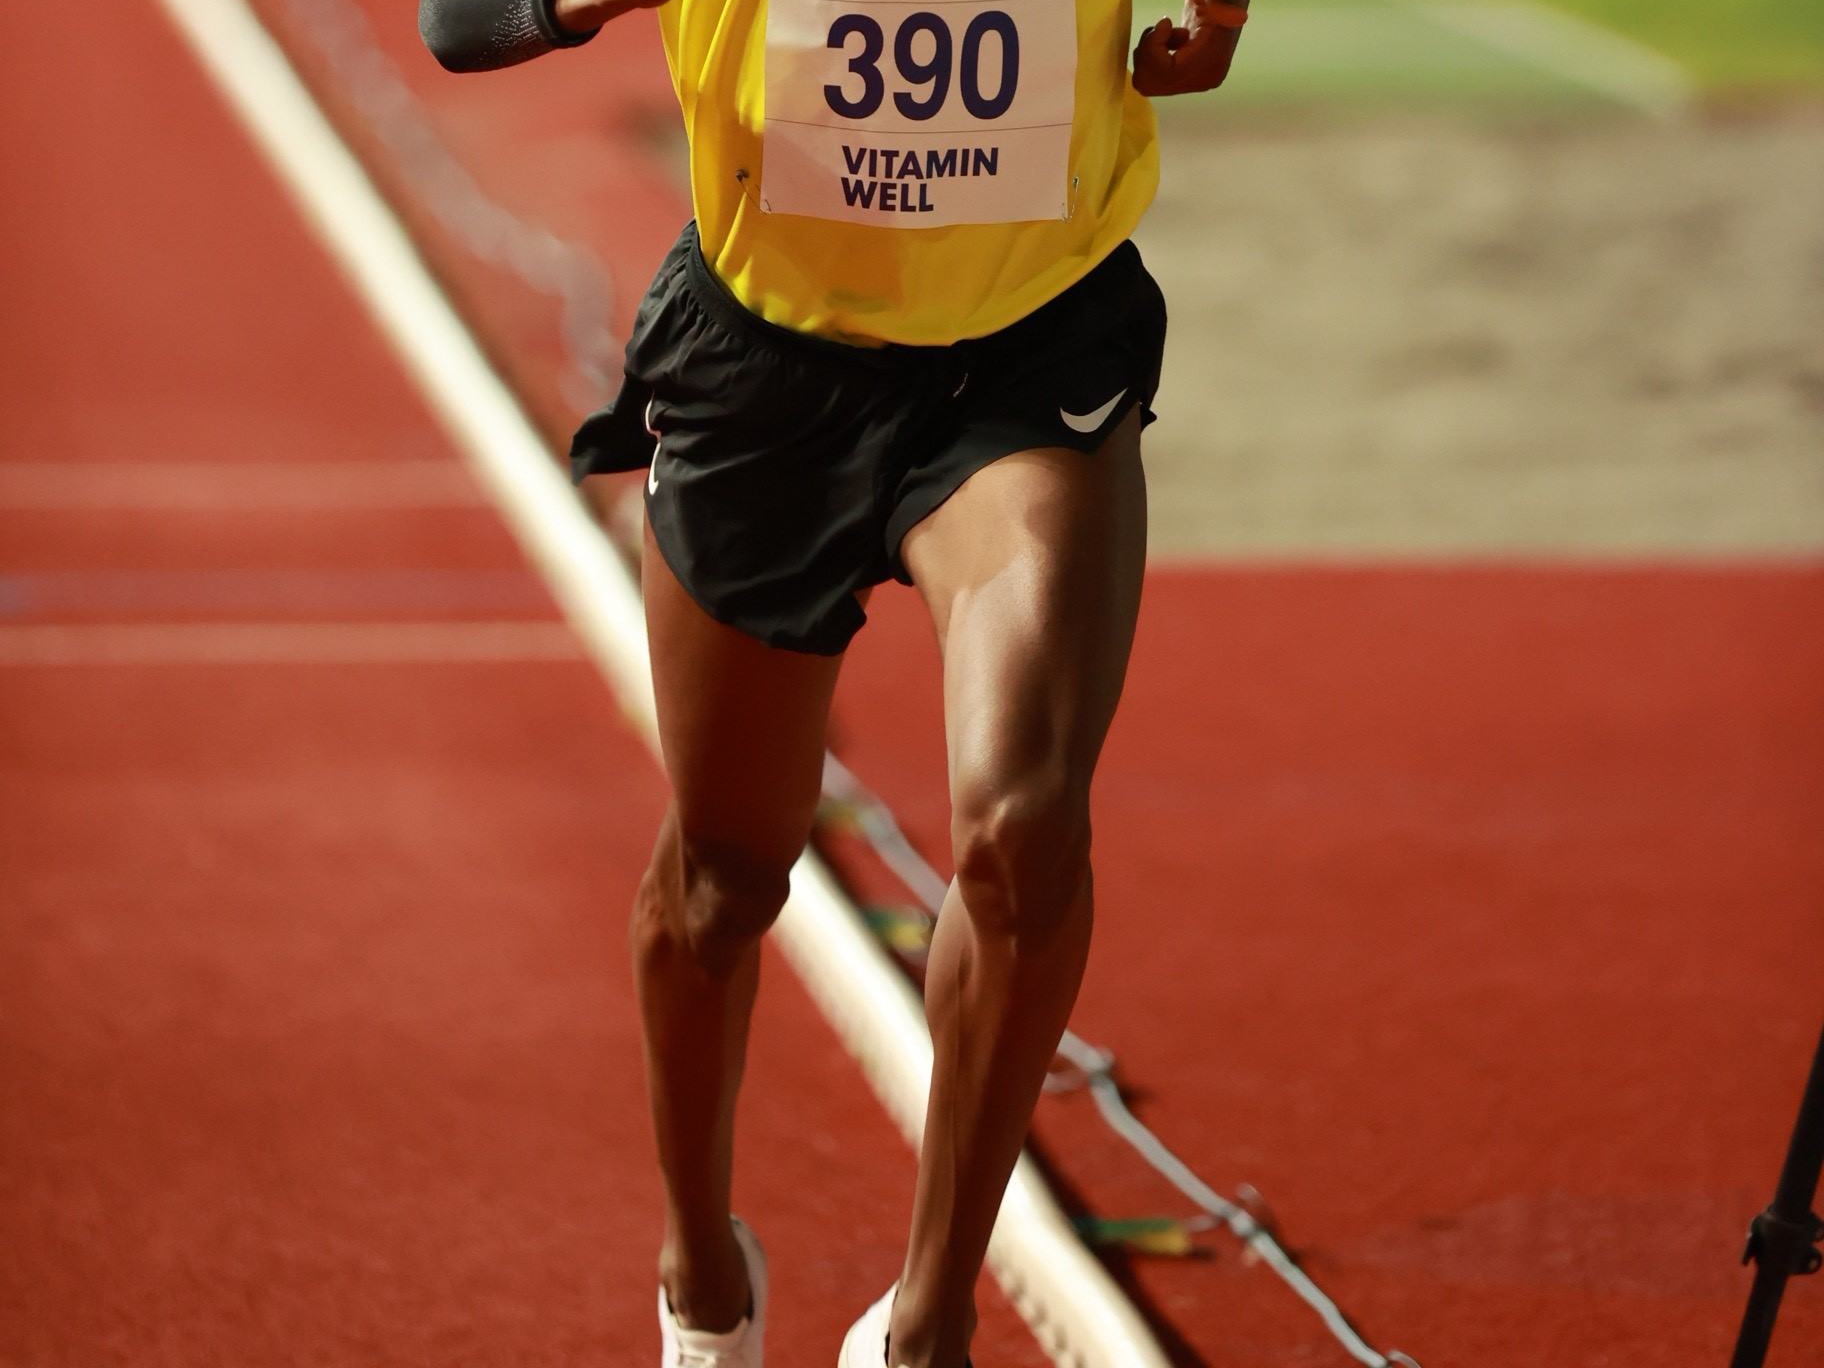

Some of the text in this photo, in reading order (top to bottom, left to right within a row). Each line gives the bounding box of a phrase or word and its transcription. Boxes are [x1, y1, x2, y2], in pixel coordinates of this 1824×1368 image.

[823, 10, 1020, 121] 390
[841, 145, 999, 180] VITAMIN
[840, 177, 934, 213] WELL
